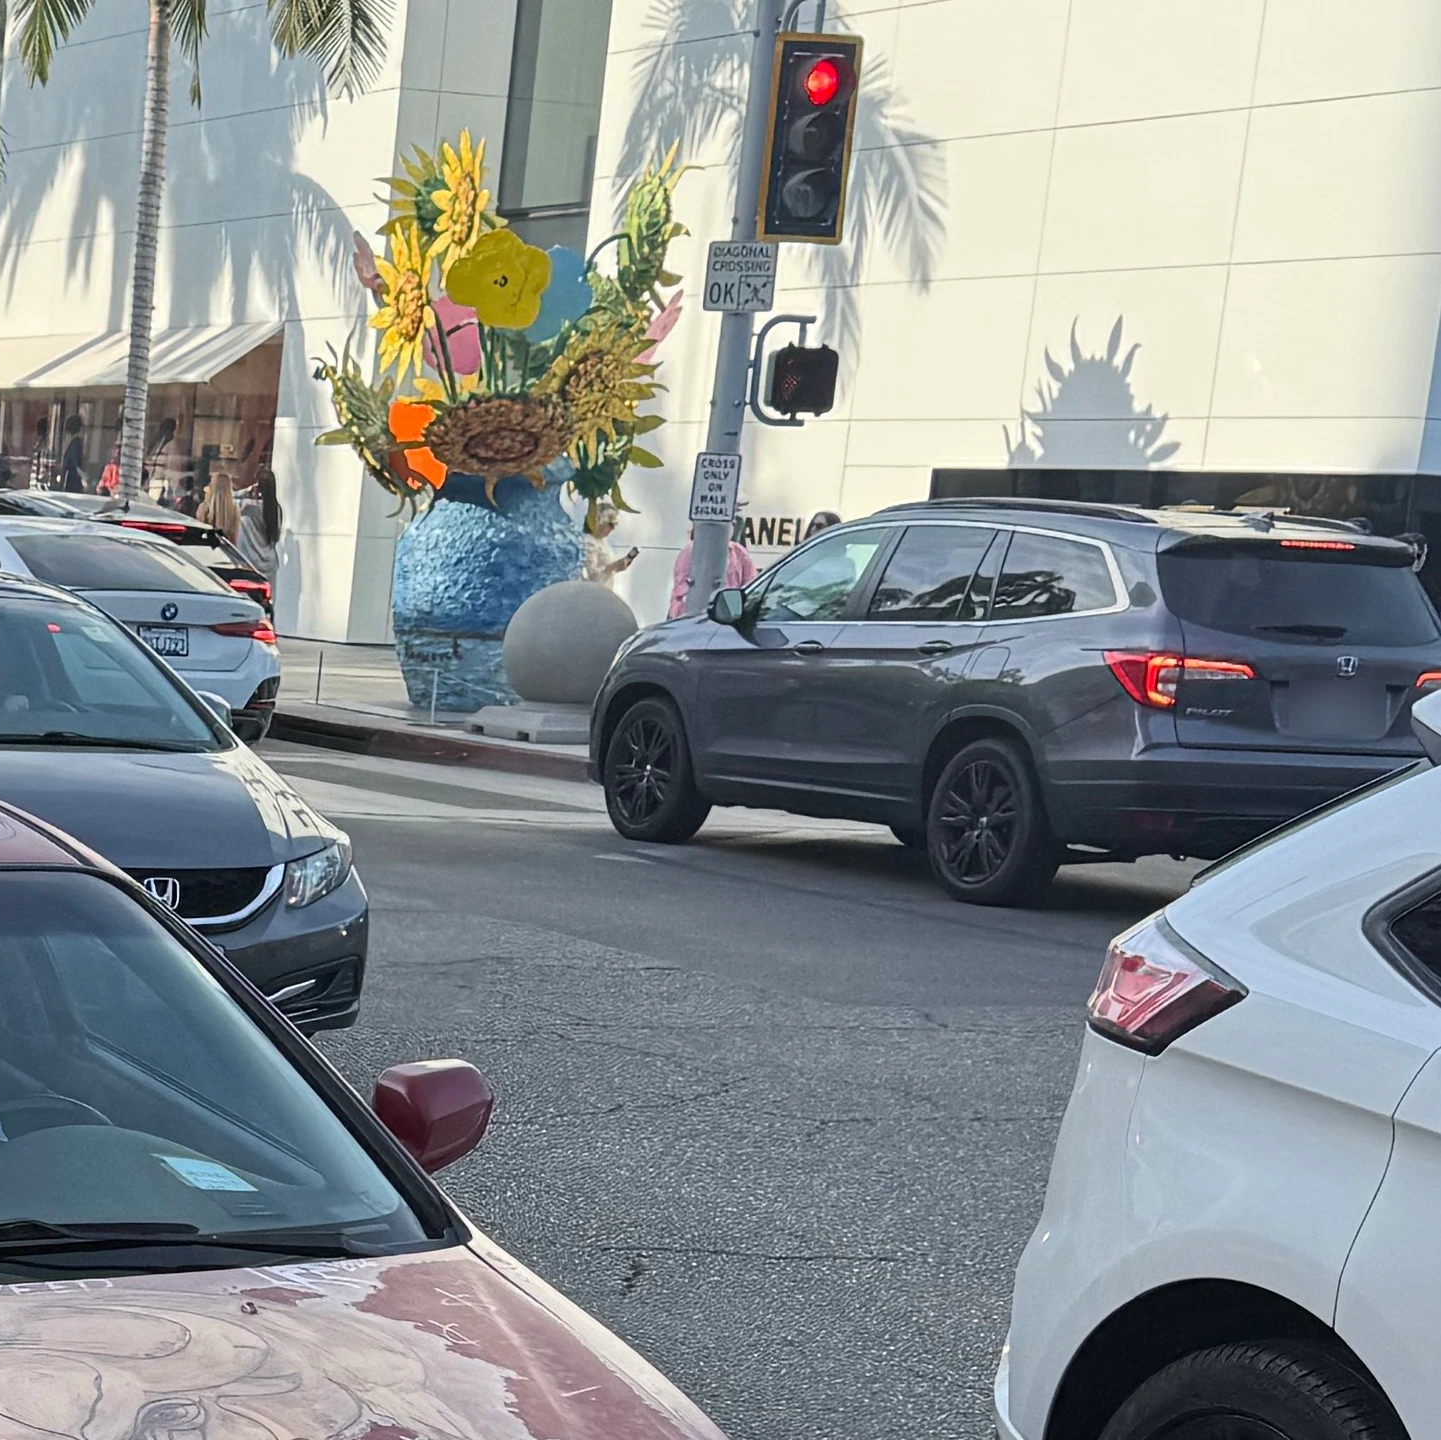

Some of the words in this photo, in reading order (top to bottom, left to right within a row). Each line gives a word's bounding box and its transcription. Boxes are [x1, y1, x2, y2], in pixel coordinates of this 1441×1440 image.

[713, 245, 772, 258] DIAGONAL
[712, 260, 771, 272] CROSSING
[709, 281, 735, 304] OK
[701, 458, 735, 469] CROSS
[703, 470, 729, 480] ONLY
[708, 482, 722, 492] ON
[700, 494, 726, 504] WALK
[694, 505, 729, 517] SIGNAL
